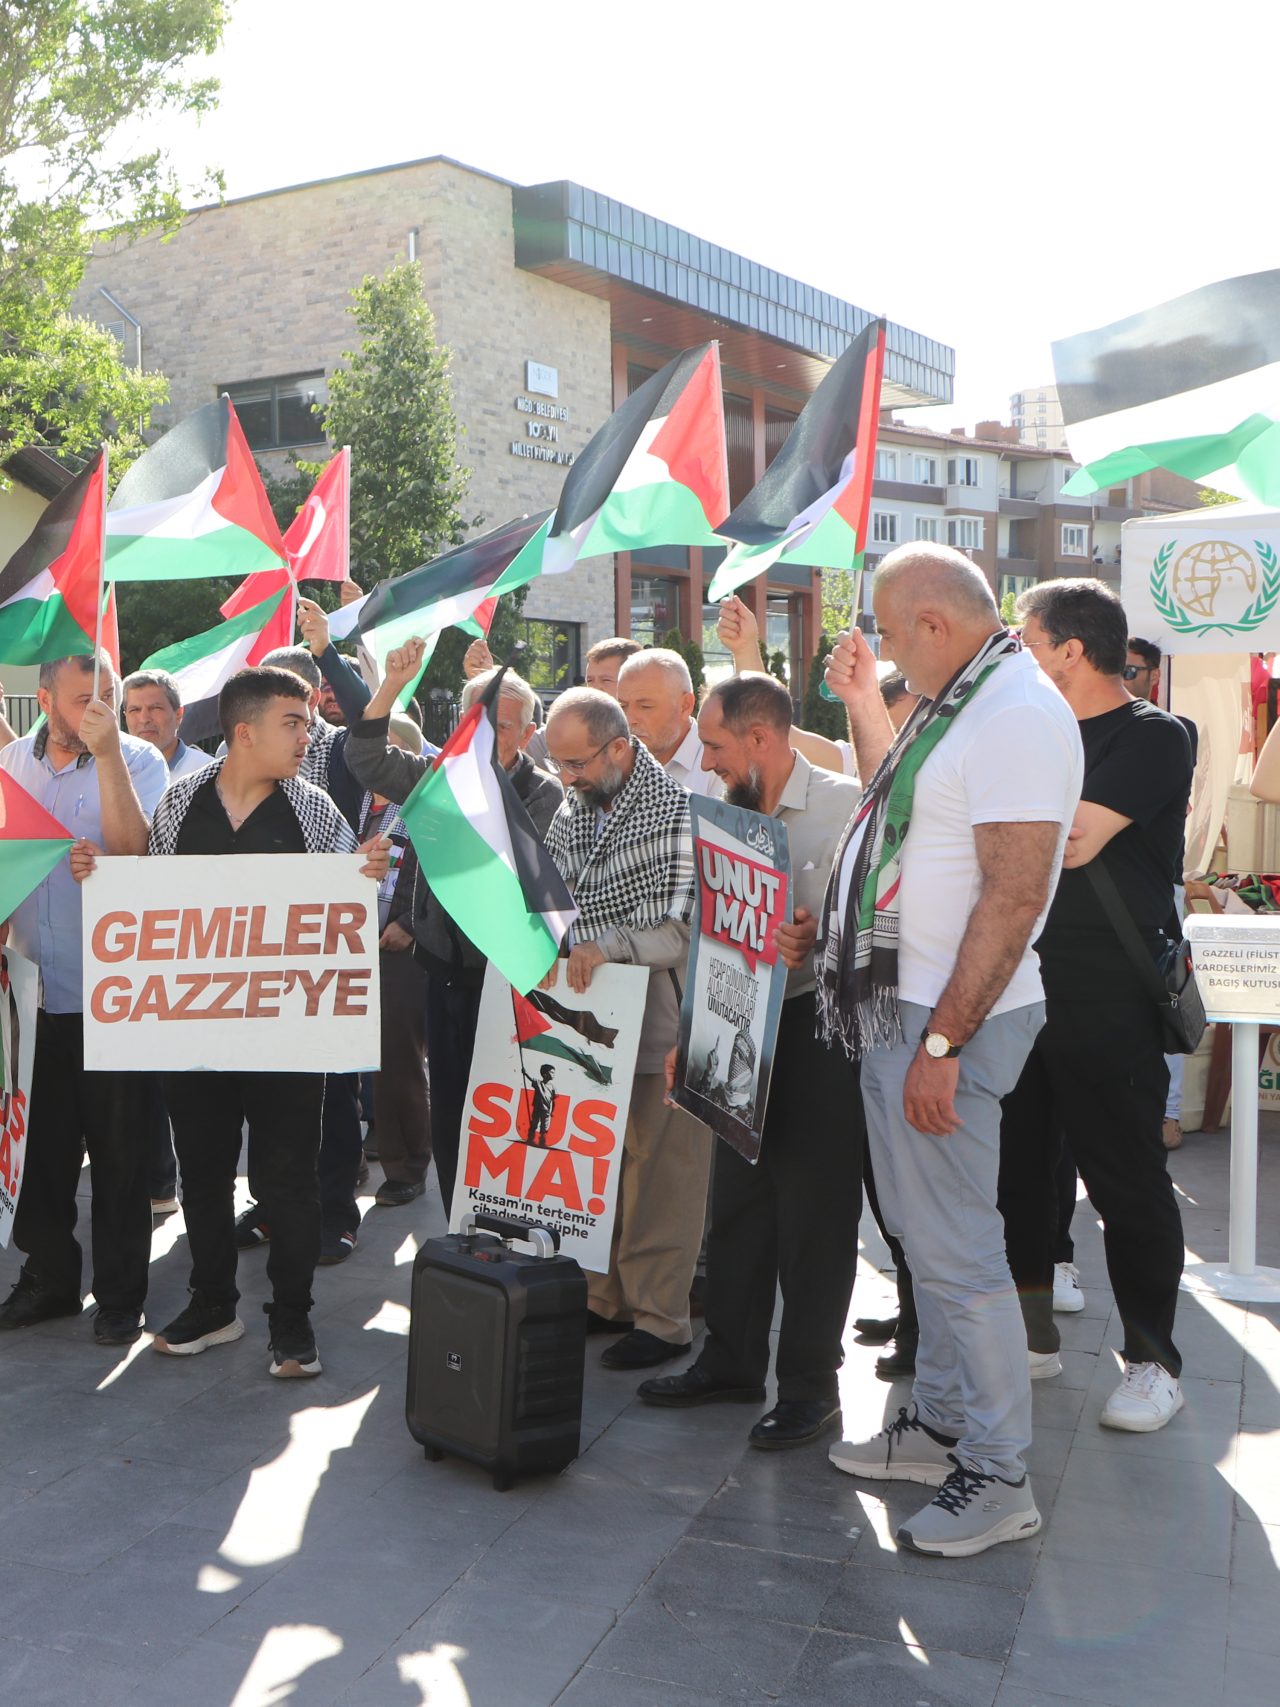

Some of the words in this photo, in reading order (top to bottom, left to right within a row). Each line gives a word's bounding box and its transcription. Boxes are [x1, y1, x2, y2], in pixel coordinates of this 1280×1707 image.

[701, 845, 780, 914] UNUT
[713, 892, 768, 952] MA!
[1195, 963, 1278, 974] KARDEŞLERİMİZ
[1202, 949, 1243, 958] GAZZELİ
[90, 968, 372, 1024] GAZZE'YE
[468, 1082, 618, 1158] SUS
[464, 1133, 611, 1216] MA!
[468, 1187, 533, 1213] Kassam'ın
[536, 1203, 597, 1227] tertemiz
